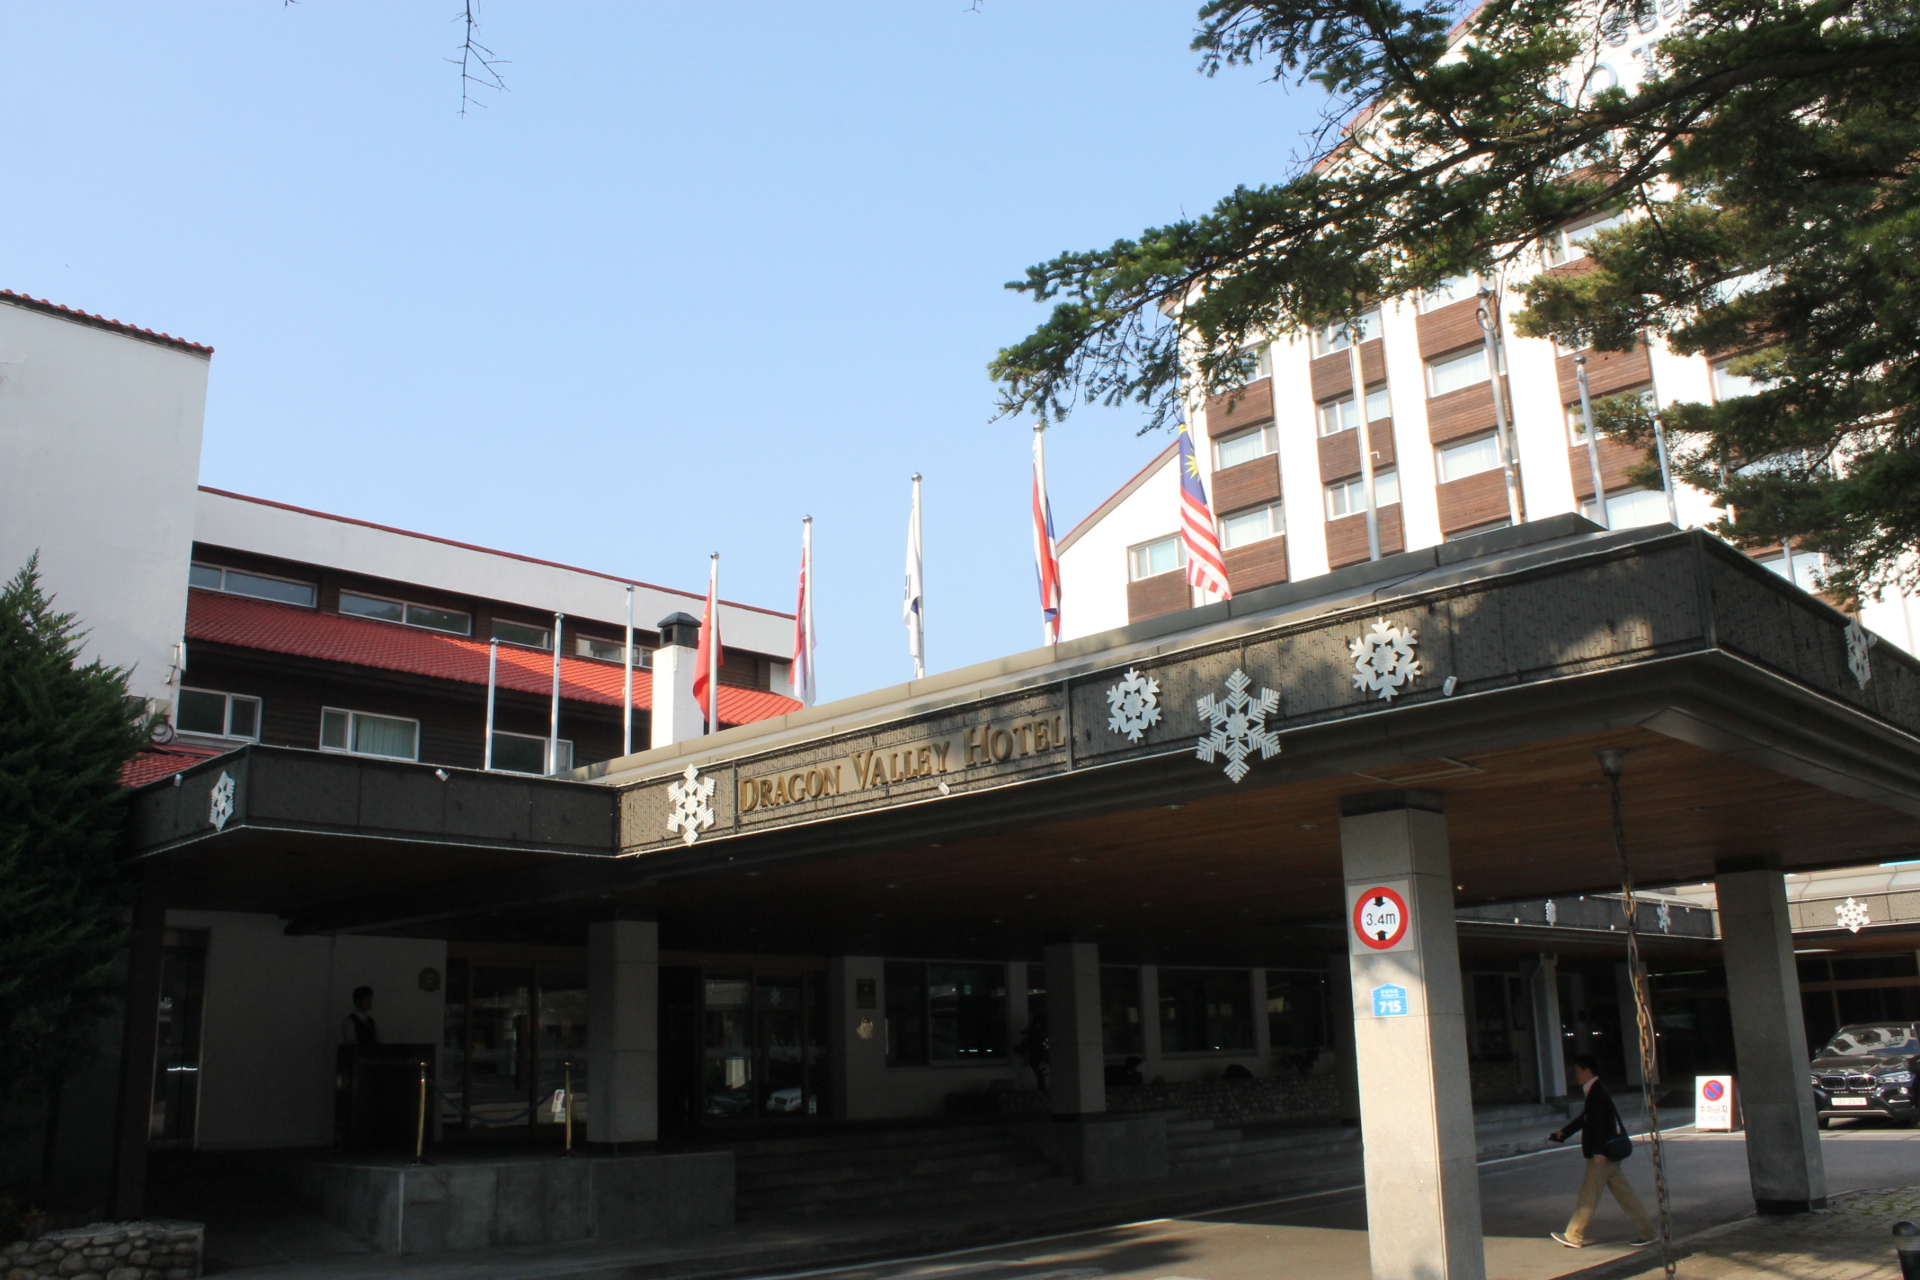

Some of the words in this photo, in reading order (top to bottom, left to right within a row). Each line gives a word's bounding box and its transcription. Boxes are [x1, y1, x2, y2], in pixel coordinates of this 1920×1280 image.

[739, 764, 841, 812] DRAGON
[849, 740, 951, 789] VALLEY
[963, 715, 1066, 768] HOTEL
[1366, 913, 1396, 926] 3.4m
[1379, 1001, 1402, 1013] 715
[1699, 1105, 1728, 1114] 주차금지
